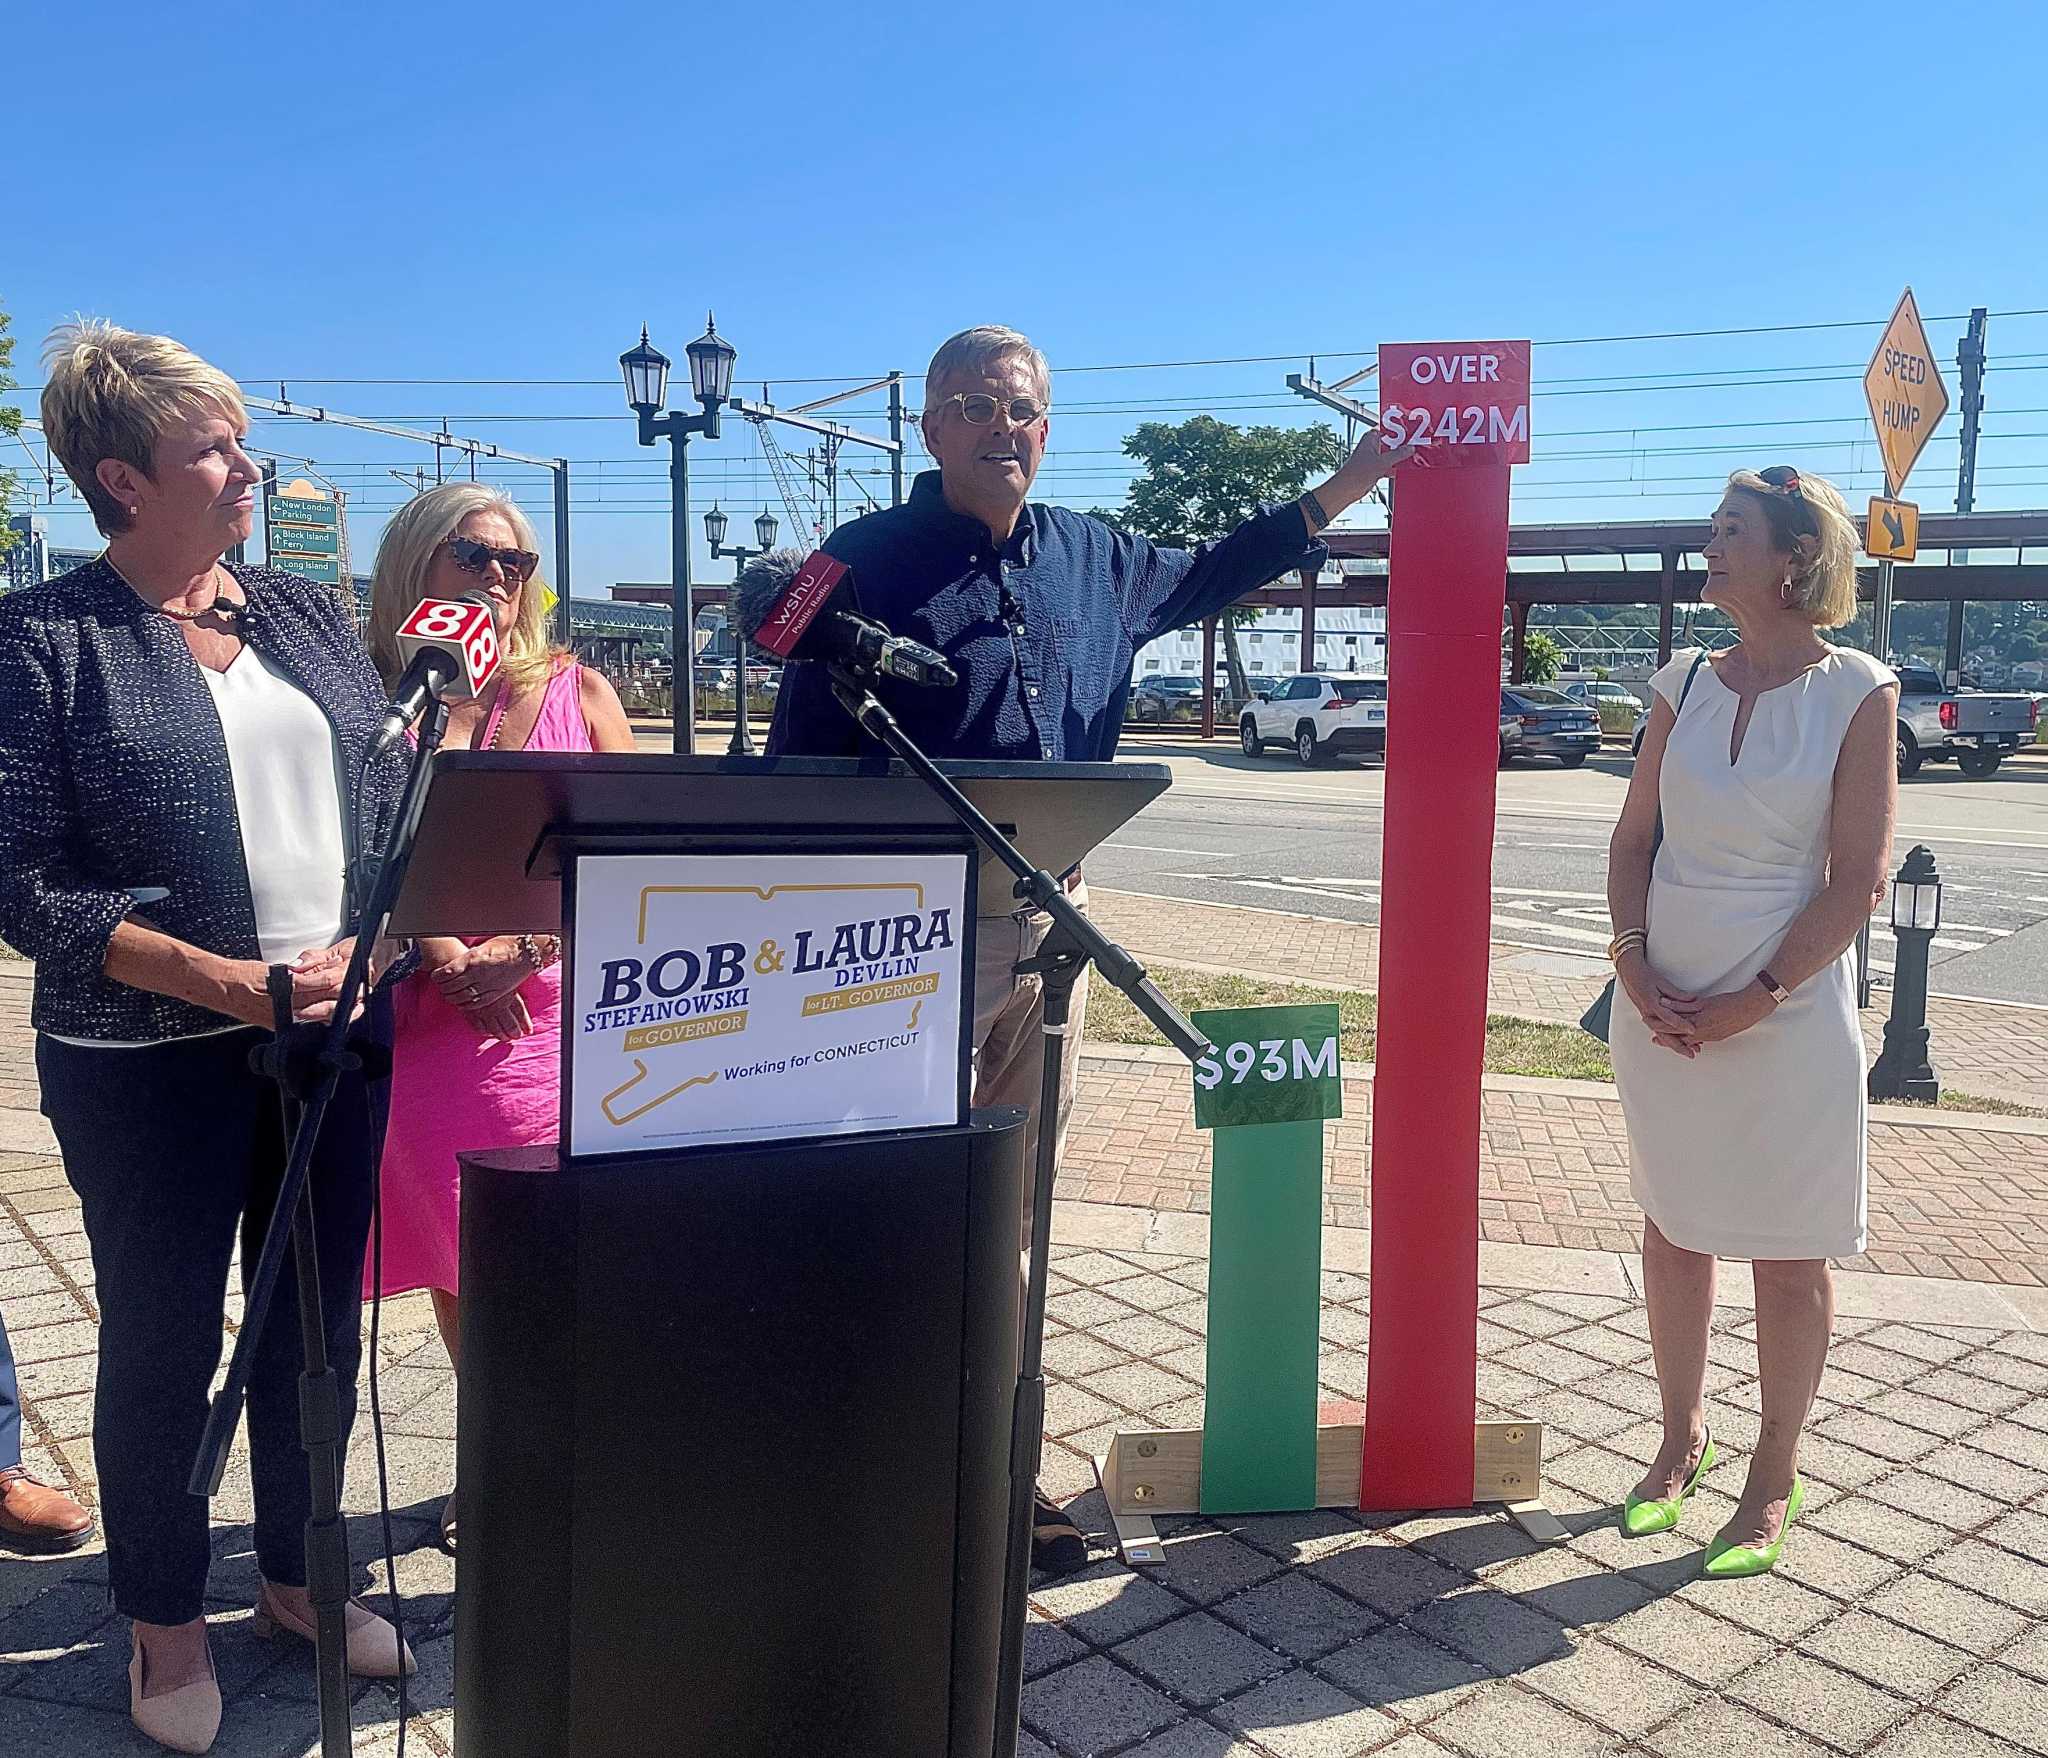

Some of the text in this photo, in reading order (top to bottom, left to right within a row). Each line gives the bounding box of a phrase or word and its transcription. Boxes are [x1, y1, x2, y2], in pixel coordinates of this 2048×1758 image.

[1410, 354, 1500, 384] OVER
[1884, 349, 1926, 385] SPEED
[1380, 404, 1528, 450] $242M
[1882, 400, 1920, 433] HUMP
[281, 501, 331, 512] New London
[282, 509, 312, 521] Parking
[282, 530, 329, 541] Block Island
[283, 540, 304, 549] Ferry
[283, 560, 329, 570] Long Island
[773, 574, 815, 624] wshu
[791, 584, 830, 633] Public Radio
[415, 604, 469, 637] 8
[469, 626, 496, 679] 8
[595, 908, 953, 1010] BOB & LAURA
[834, 956, 920, 987] DEVLIN
[584, 987, 750, 1033] STEFANOWSKI
[806, 978, 934, 1010] for LT. GOVERNOR
[628, 1016, 742, 1045] for GOVERNOR
[724, 1032, 919, 1080] Working for CONNECTICUT
[1194, 1036, 1338, 1090] $93M
